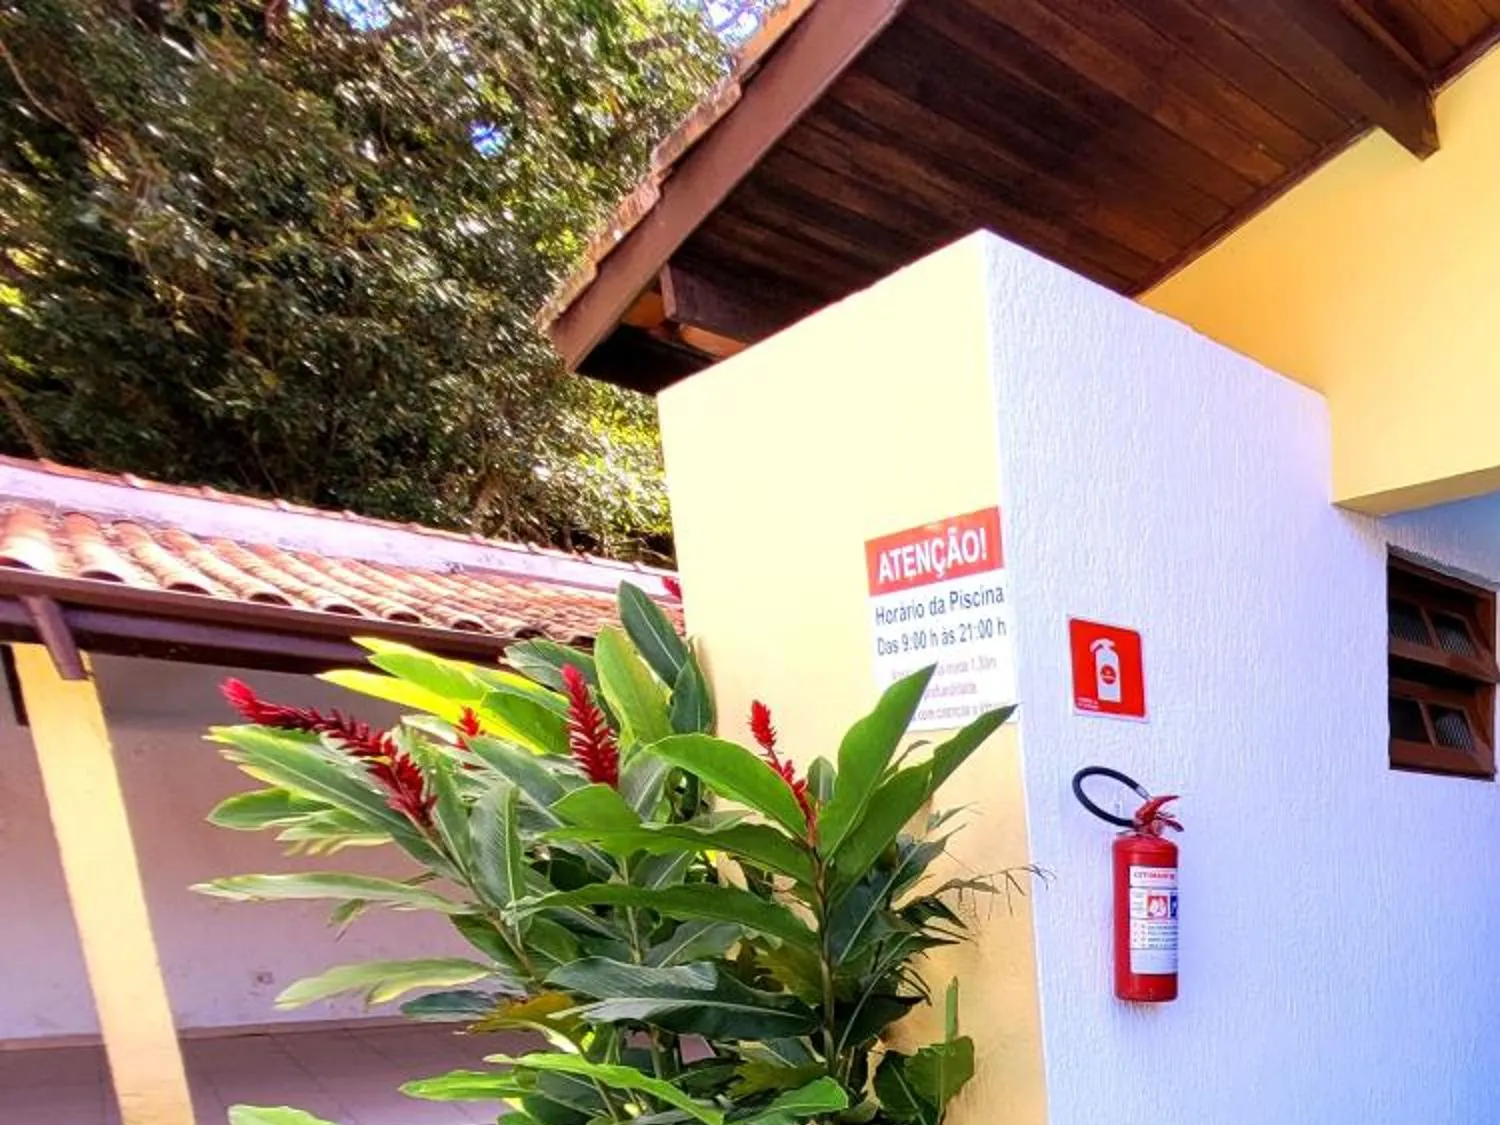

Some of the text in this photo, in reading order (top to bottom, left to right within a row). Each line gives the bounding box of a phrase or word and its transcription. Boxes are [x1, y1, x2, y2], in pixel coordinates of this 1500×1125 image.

[879, 527, 988, 583] ATENÇÃO!
[876, 586, 1004, 625] Horário da Piscina
[877, 637, 898, 656] Das
[930, 628, 938, 647] h
[959, 618, 993, 643] 21:00
[997, 617, 1007, 636] h
